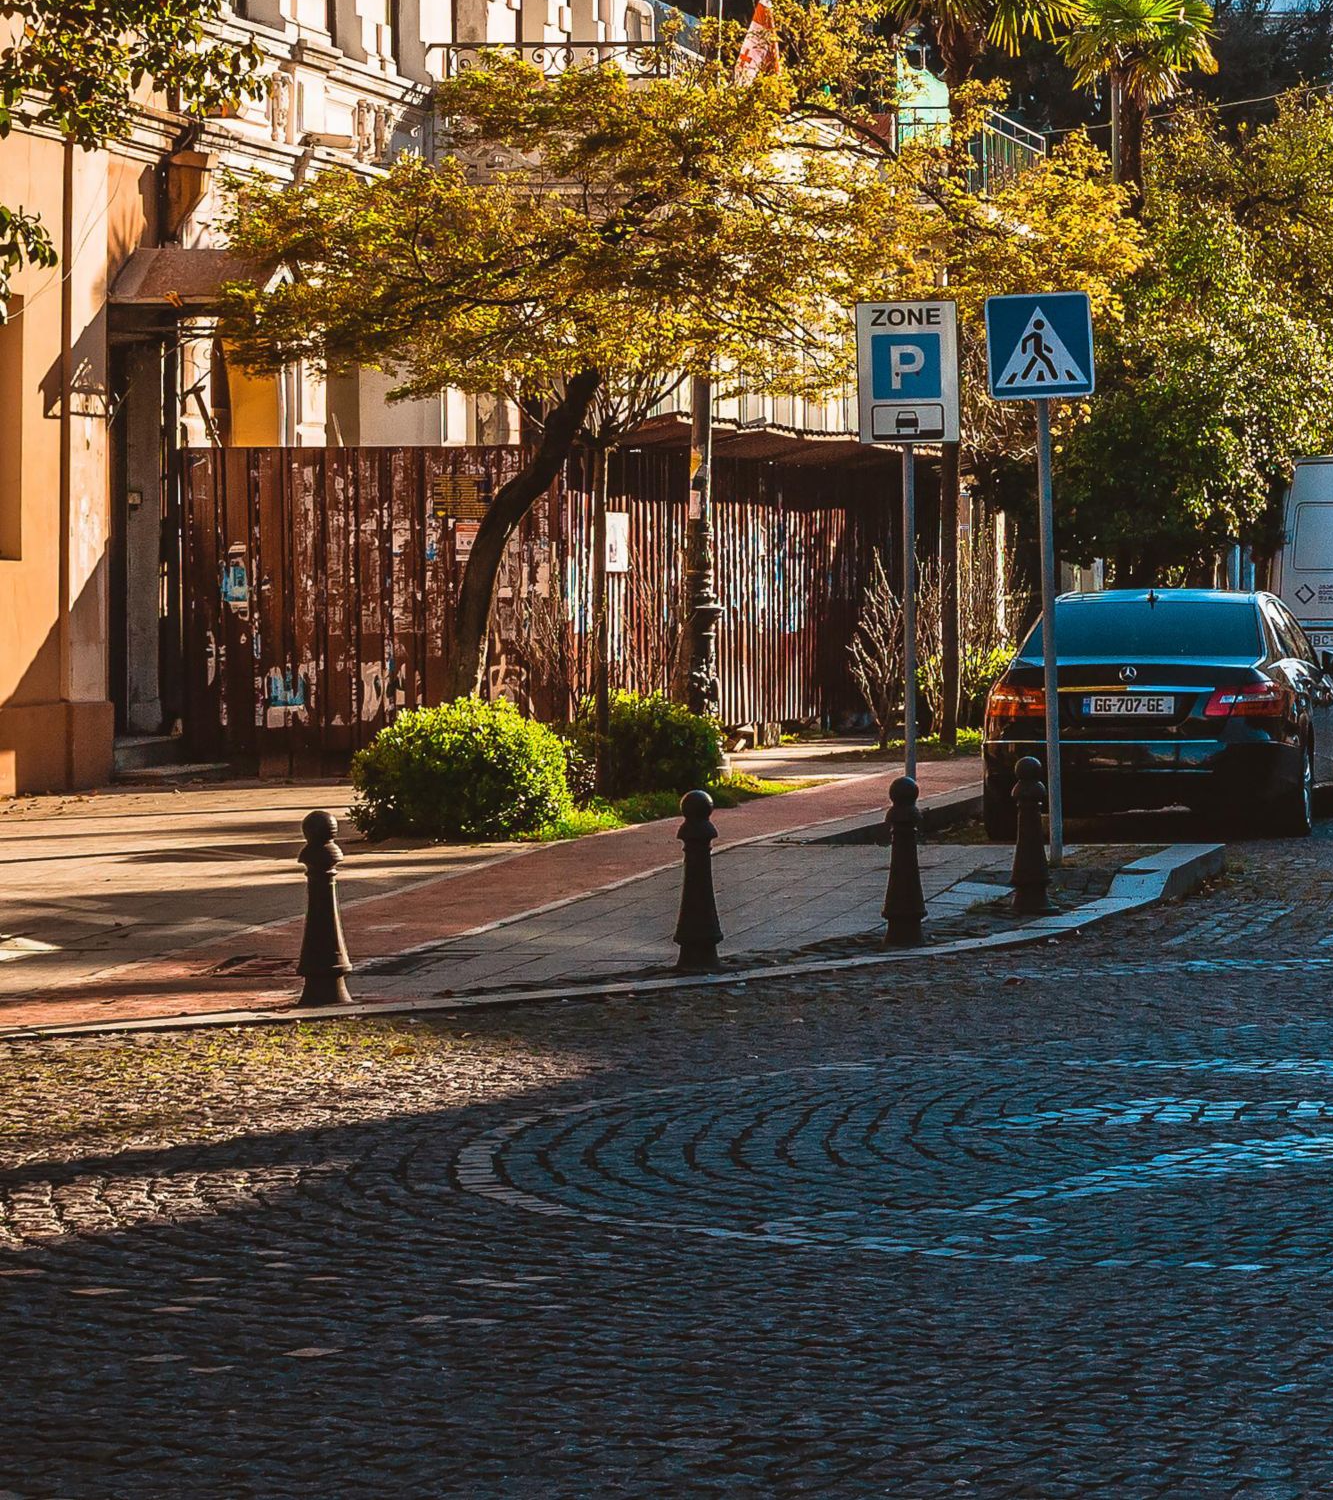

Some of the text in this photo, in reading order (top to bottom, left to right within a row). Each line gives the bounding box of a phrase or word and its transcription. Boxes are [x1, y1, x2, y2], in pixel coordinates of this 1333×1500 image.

[871, 308, 941, 326] ZONE
[890, 345, 925, 390] P
[1094, 698, 1164, 712] GG-707-GE
